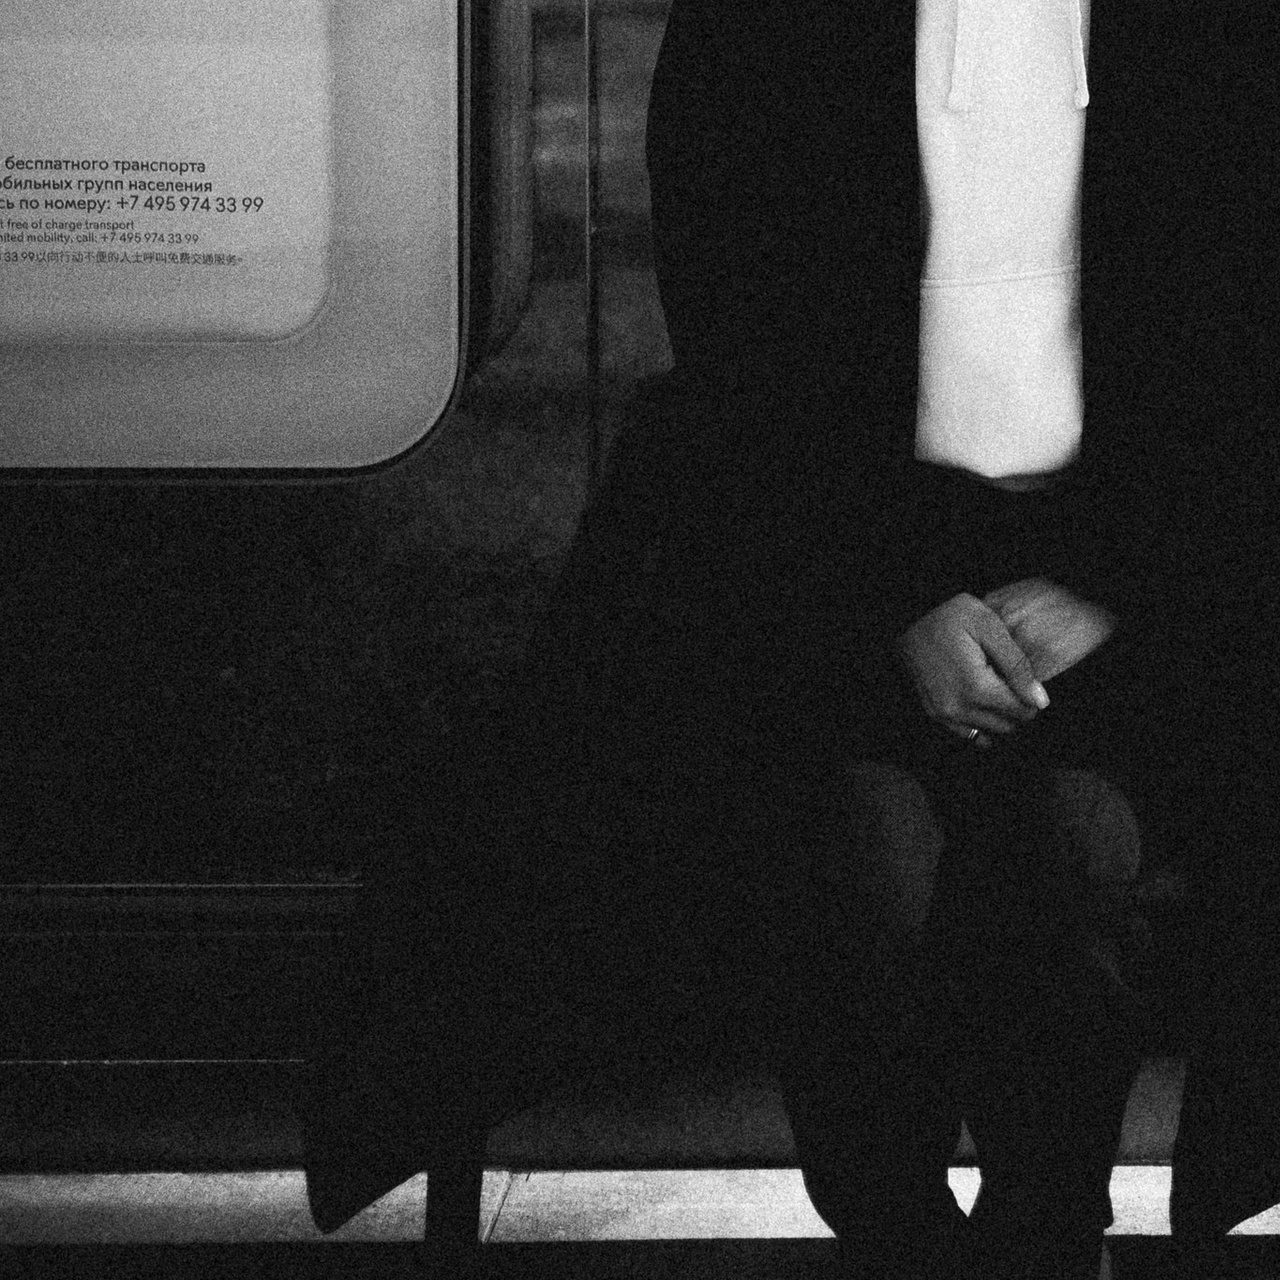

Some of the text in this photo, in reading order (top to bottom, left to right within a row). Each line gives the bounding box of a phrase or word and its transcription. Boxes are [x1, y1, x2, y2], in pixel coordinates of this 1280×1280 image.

[5, 155, 206, 175] бесплатного транспорта
[0, 176, 213, 194] бильных групп населения
[19, 198, 40, 210] по
[45, 197, 111, 214] номеру:
[116, 195, 139, 211] +7
[143, 195, 176, 212] 495
[180, 196, 212, 213] 974
[215, 197, 237, 213] 33
[241, 196, 265, 213] 99
[7, 218, 29, 230] free
[31, 218, 43, 230] of
[45, 219, 82, 232] charge
[85, 220, 135, 232] transport
[100, 232, 116, 244] +7
[119, 232, 142, 245] 495
[144, 232, 165, 245] 974
[167, 233, 182, 245] 33
[184, 232, 200, 245] 99
